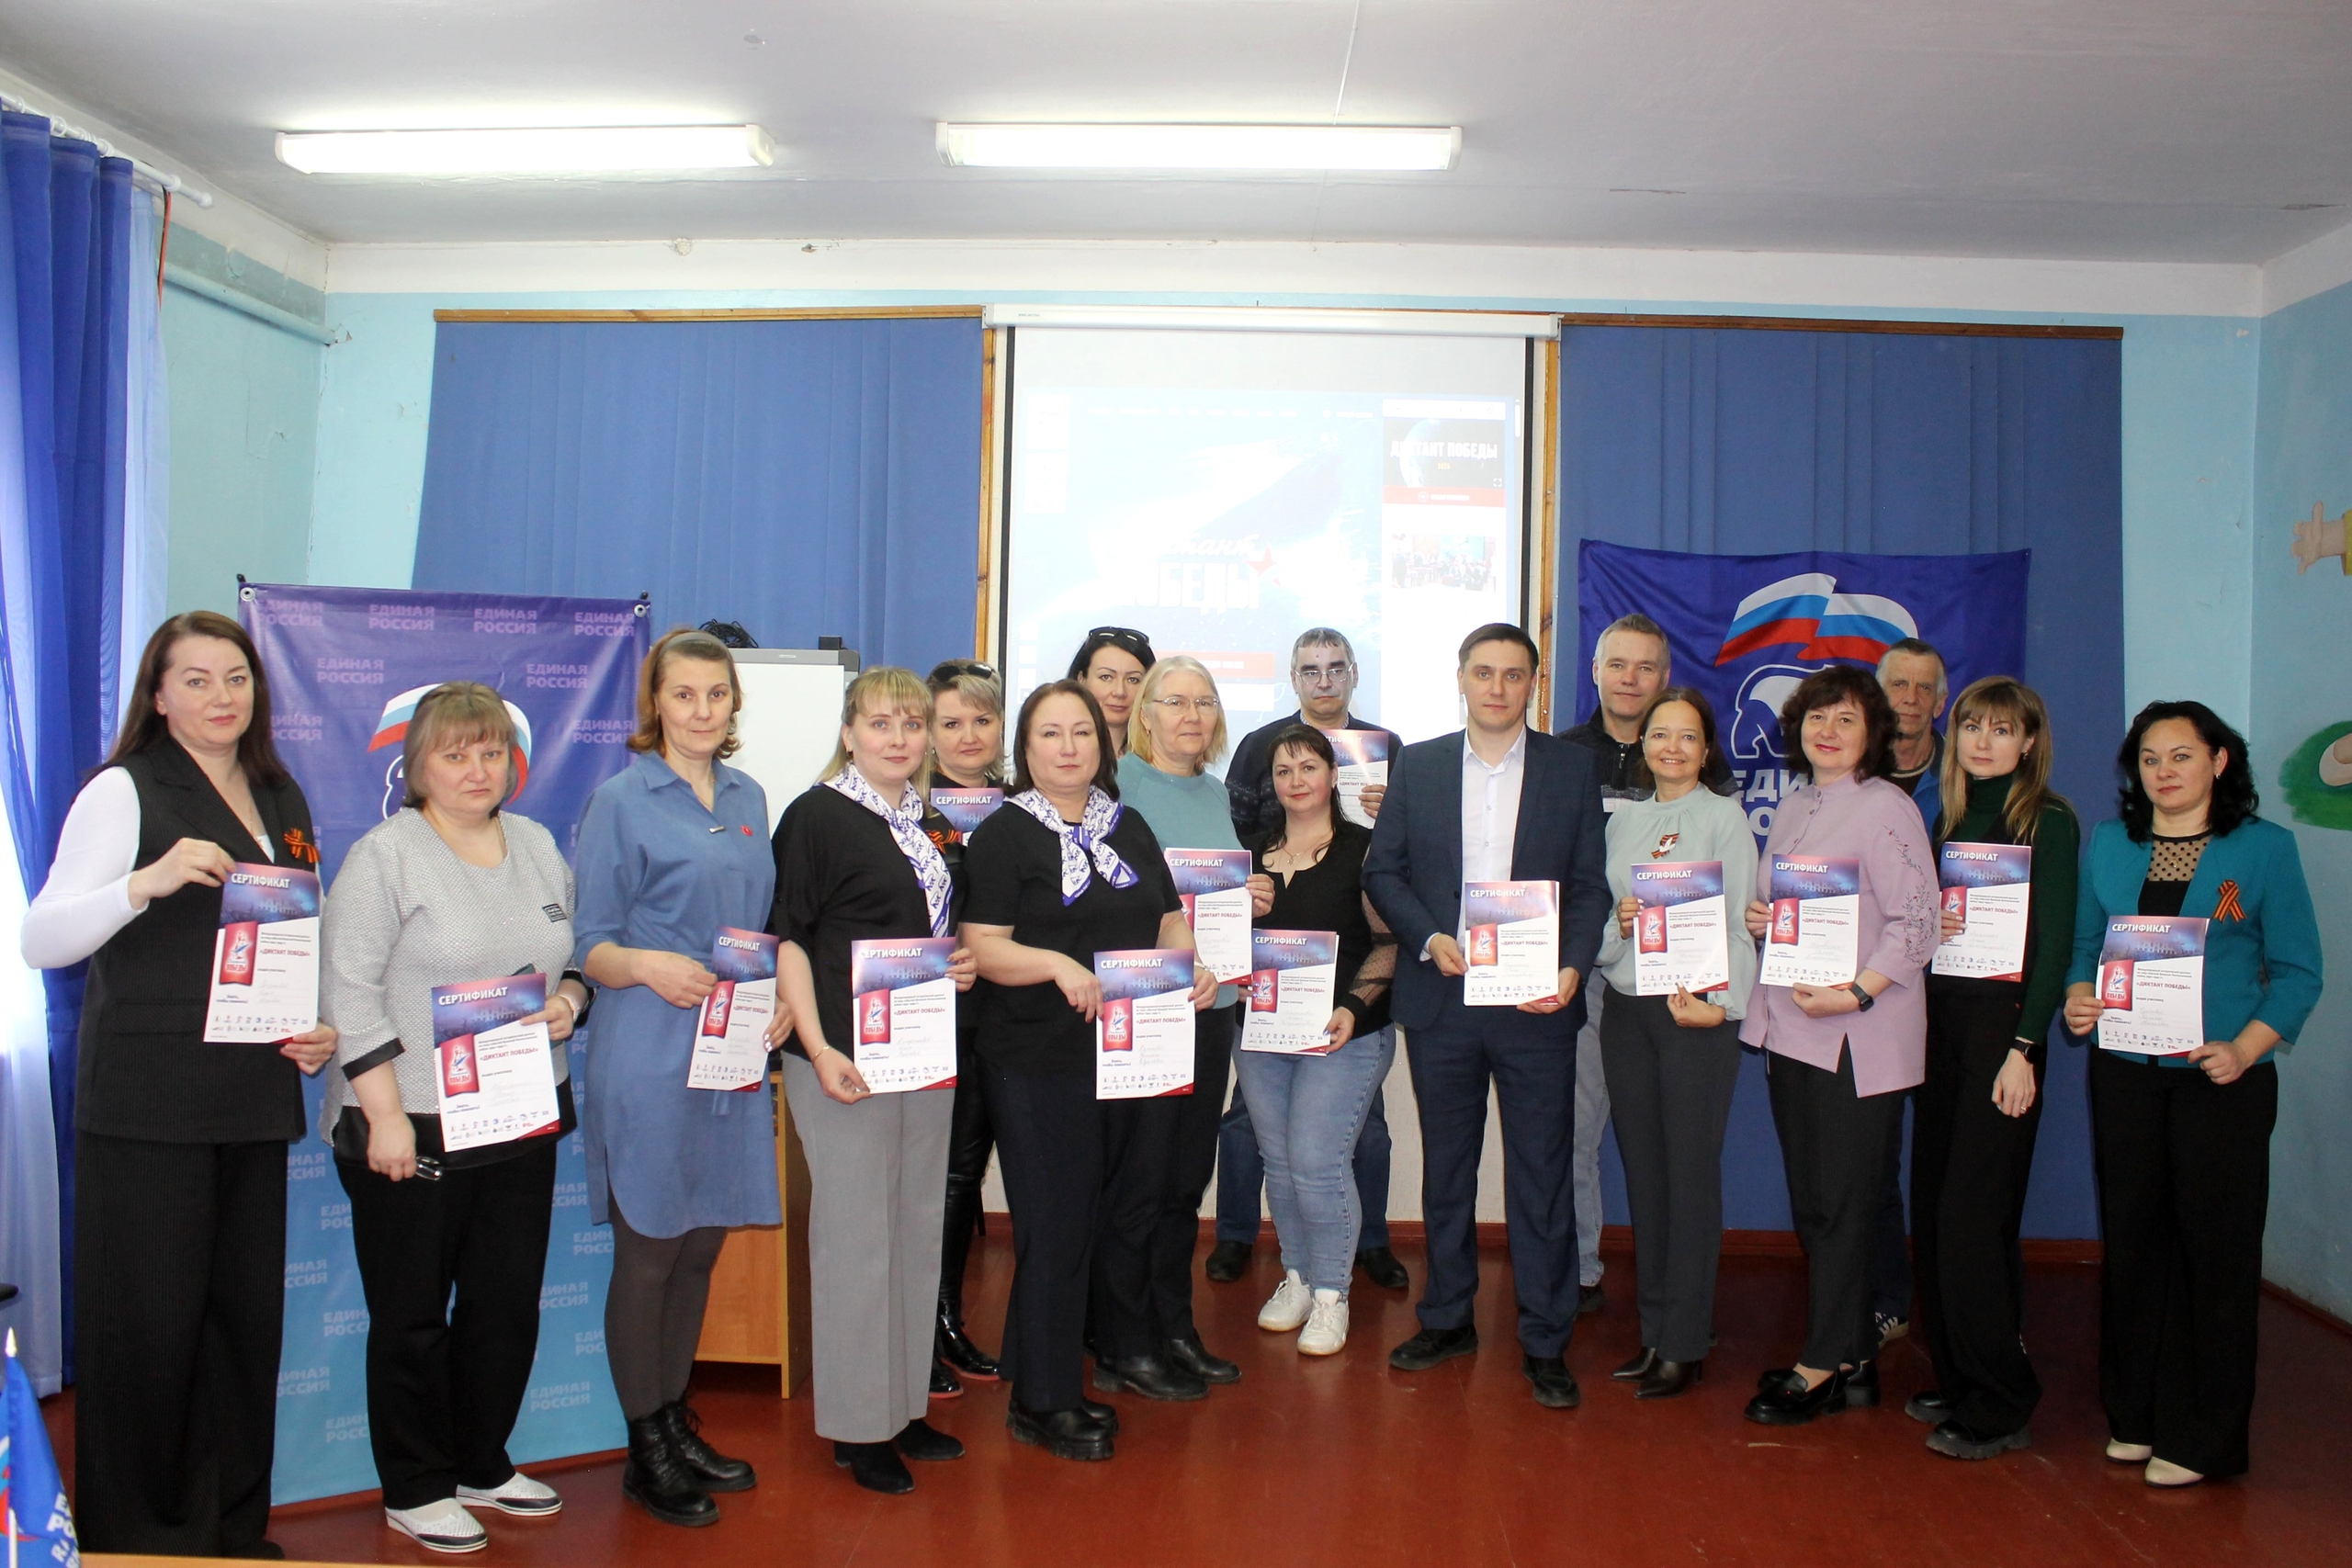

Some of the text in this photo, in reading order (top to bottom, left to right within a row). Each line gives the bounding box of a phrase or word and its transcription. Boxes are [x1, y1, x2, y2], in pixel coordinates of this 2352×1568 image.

[1447, 443, 1498, 459] ПОБЕДЫ
[369, 604, 435, 616] ЕДИНАЯ
[474, 608, 537, 620] ЕДИНАЯ
[369, 617, 435, 631] РОССИЯ
[574, 612, 635, 624] ЕДИНАЯ
[473, 621, 537, 634] РОССИЯ
[574, 625, 634, 637] РОССИЯ
[317, 658, 384, 670] ЕДИНАЯ
[526, 663, 588, 675] ЕДИНАЯ
[316, 671, 383, 683] РОССИЯ
[526, 676, 587, 688] РОССИЯ
[272, 715, 321, 726] ИНАЯ
[272, 728, 321, 740] ССИЯ
[572, 732, 628, 743] РОССИ
[936, 795, 991, 805] СЕРТИФИКАТ
[1170, 858, 1224, 867] СЕРТИФИКАТ
[1946, 851, 1998, 862] СЕРТИФИКАТ
[1776, 862, 1828, 874] СЕРТИФИКАТ
[230, 873, 290, 889] СЕРТИФИКАТ
[1636, 870, 1692, 881] СЕРТИФИКАТ
[1470, 888, 1526, 897] СЕРТИФИКАТ
[2112, 923, 2171, 933] СЕРТИФИКАТ
[718, 936, 761, 953] СЕРТИФИКАТ
[1255, 936, 1306, 945] СЕРТИФИКАТ
[858, 948, 922, 958] СЕРТИФИКАТ
[1101, 958, 1163, 969] СЕРТИФИКАТ
[438, 987, 509, 1006] СЕРТИФИКАТ
[322, 1203, 351, 1217] ЕДИ
[322, 1216, 352, 1230] РОС
[573, 1231, 612, 1244] ЕДИН
[573, 1243, 614, 1256] РОСС
[285, 1259, 327, 1274] ИНАЯ
[285, 1272, 327, 1288] ССИЯ
[539, 1294, 588, 1309] ОССИЯ
[322, 1309, 368, 1324] ЕДИН
[323, 1321, 369, 1337] РОСС
[574, 1330, 605, 1342] ЕДИ
[575, 1342, 605, 1355] РОС
[530, 1382, 590, 1398] ЕДИНАЯ
[530, 1393, 590, 1412] РОССИЯ
[326, 1427, 368, 1443] РОСС
